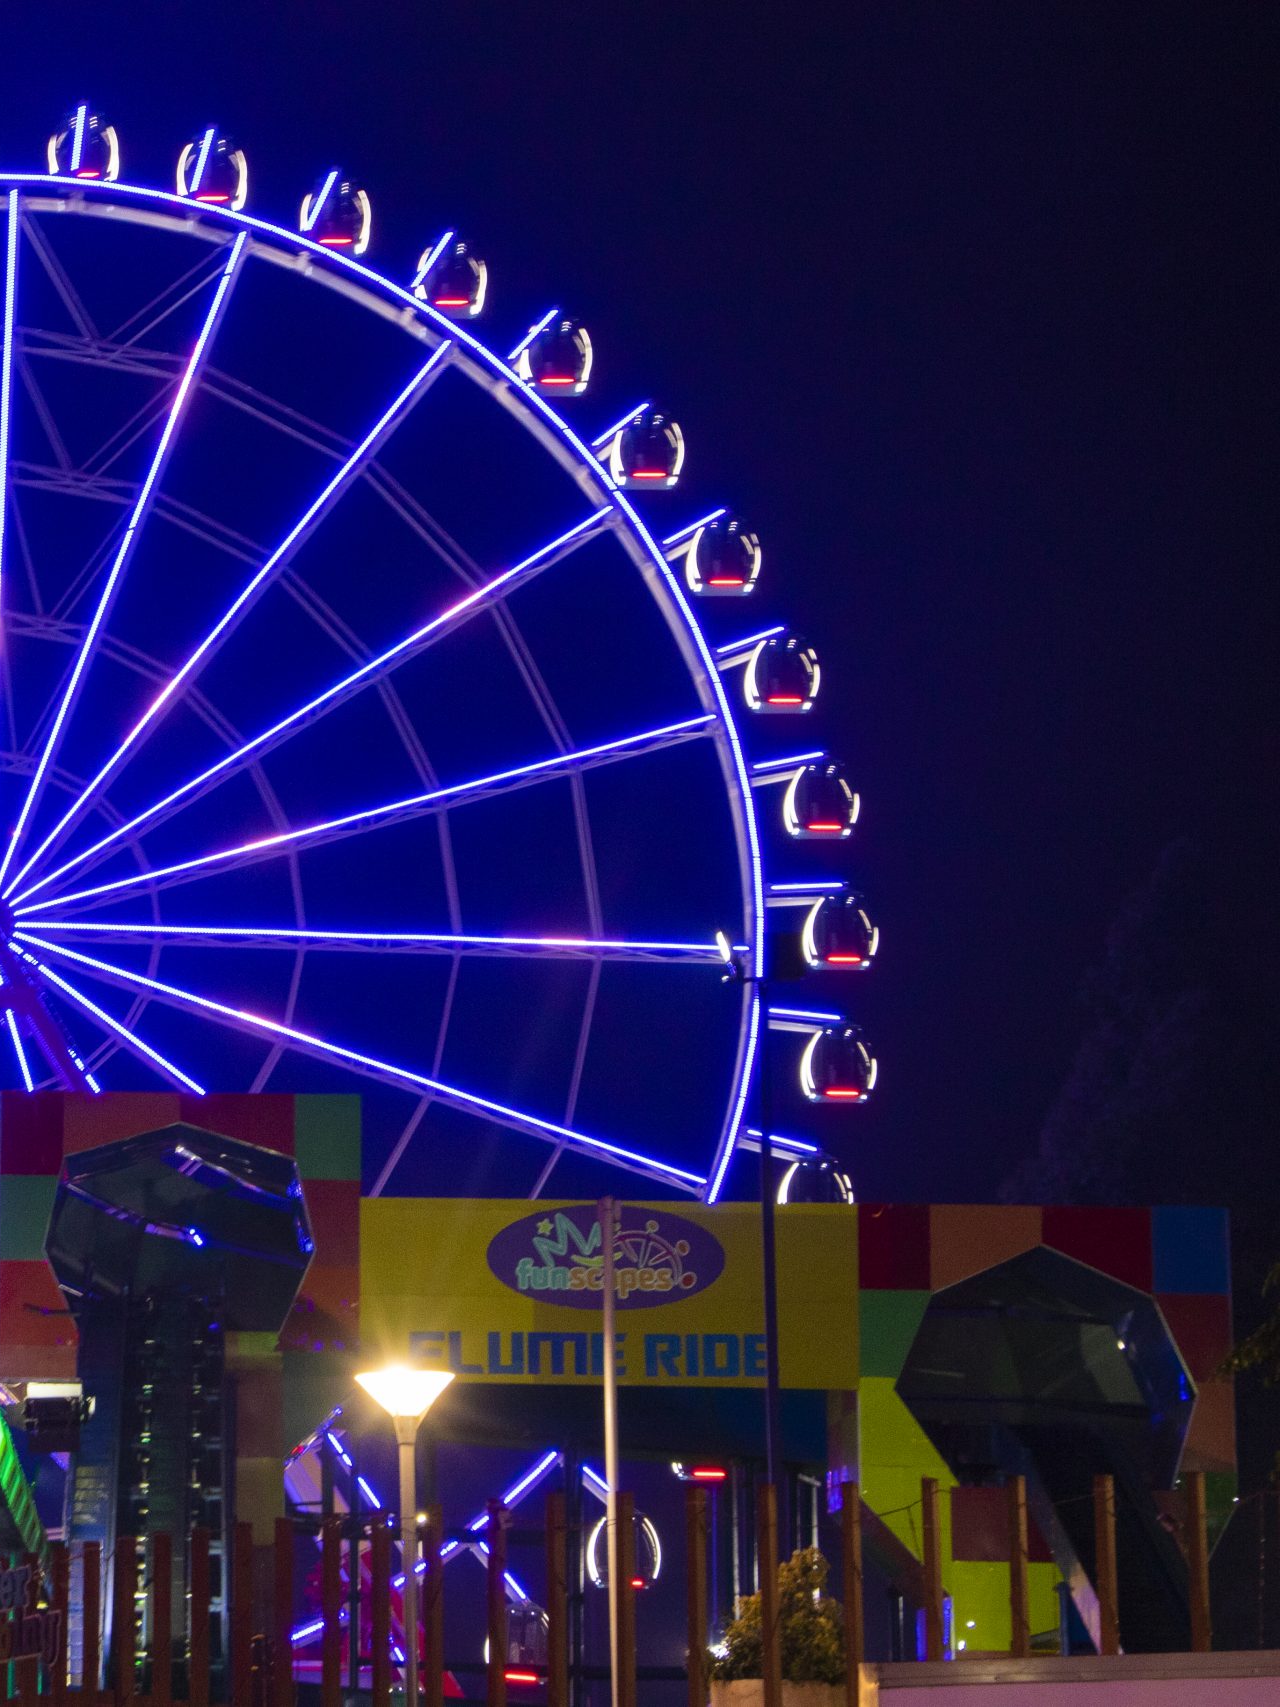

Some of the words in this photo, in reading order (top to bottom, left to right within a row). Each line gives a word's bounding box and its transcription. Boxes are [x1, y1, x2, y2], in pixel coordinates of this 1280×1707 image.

[516, 1257, 673, 1299] funscpes
[409, 1331, 627, 1376] FLUME
[643, 1333, 768, 1378] RIDE
